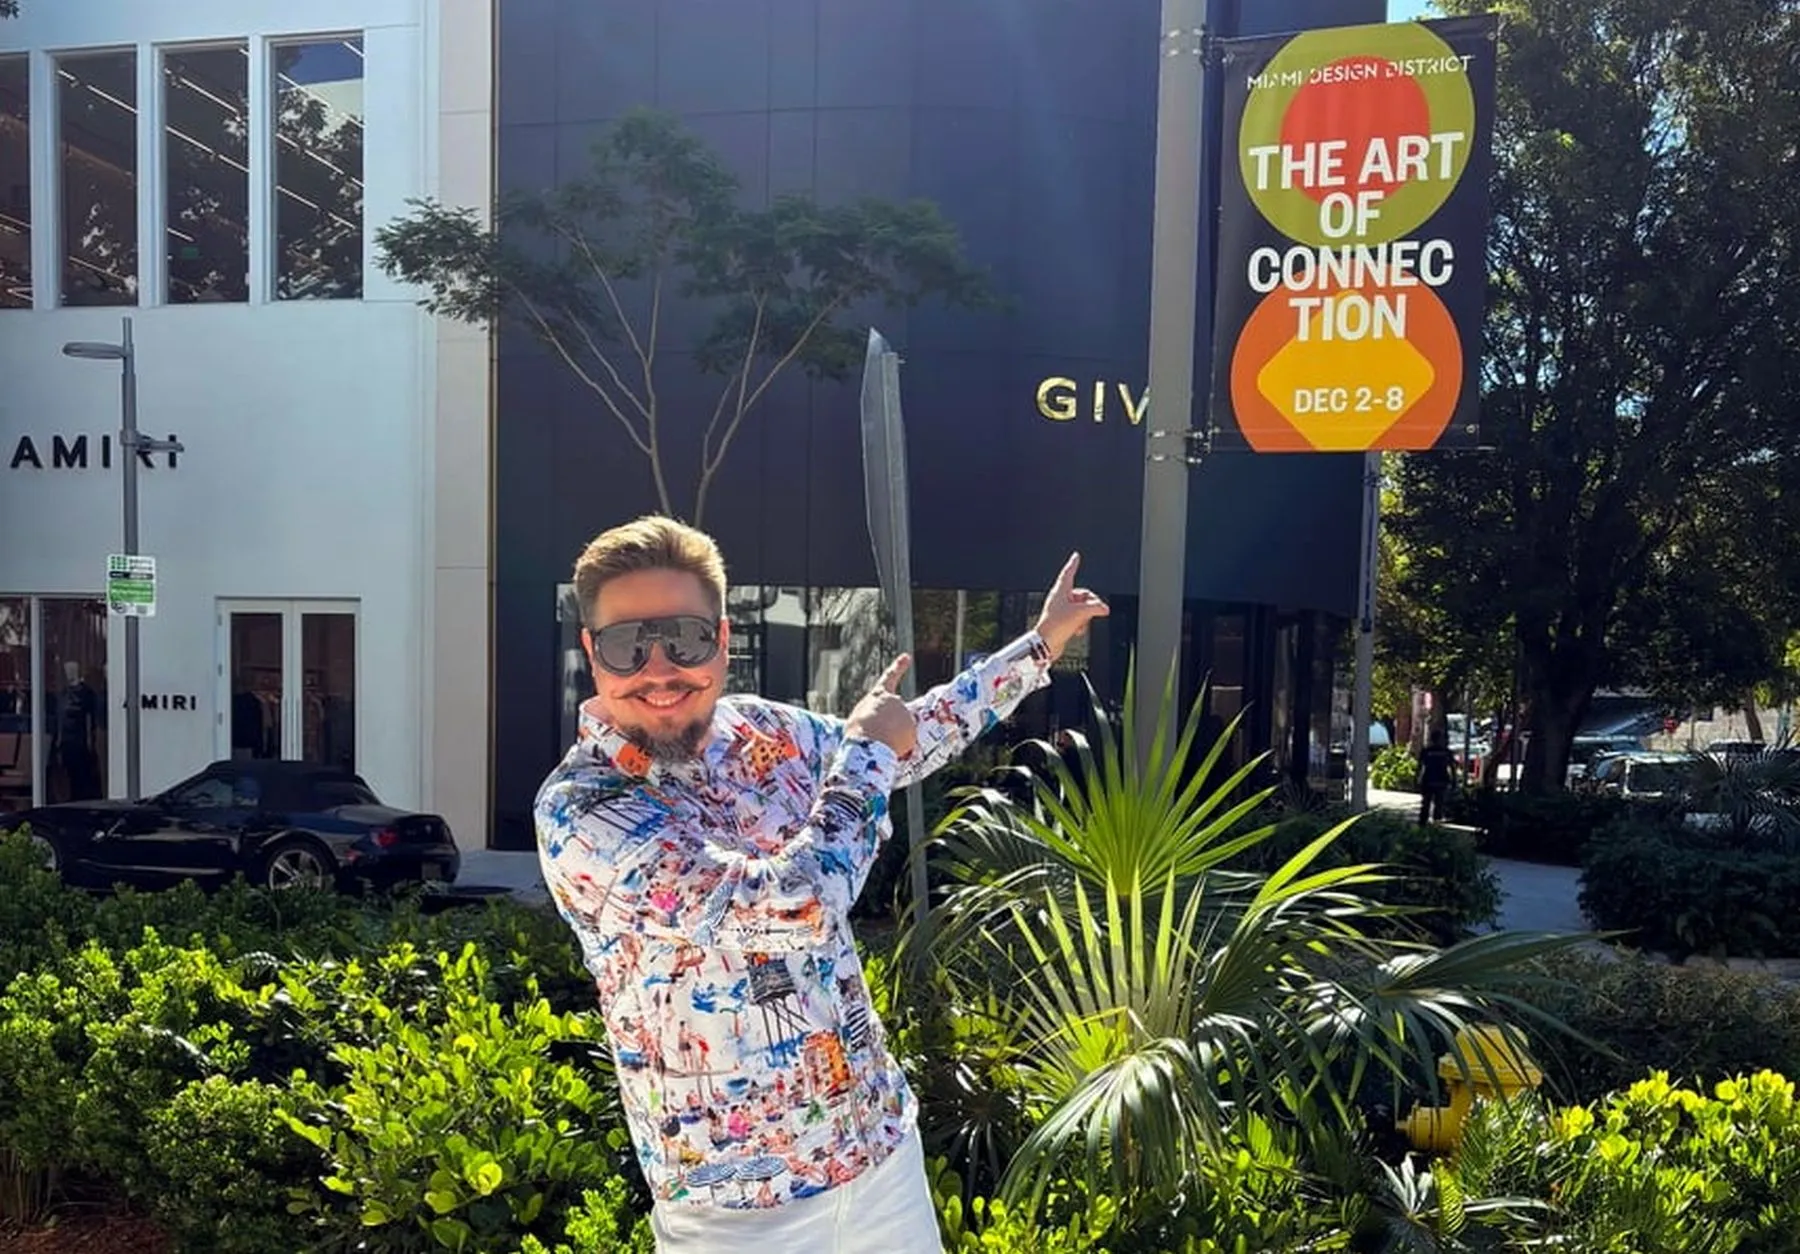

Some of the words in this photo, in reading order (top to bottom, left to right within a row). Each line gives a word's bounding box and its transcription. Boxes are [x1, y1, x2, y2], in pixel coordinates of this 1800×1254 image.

[1247, 70, 1302, 90] MIAMI
[1310, 62, 1377, 85] DESIGN
[1386, 55, 1474, 79] DISTRICT
[1249, 139, 1347, 190] THE
[1358, 131, 1464, 184] ART
[1319, 190, 1384, 238] OF
[1248, 239, 1454, 292] CONNEC
[1288, 293, 1406, 342] TION
[1293, 387, 1348, 414] DEC
[1354, 386, 1405, 412] 2-8
[122, 693, 197, 711] MIRI
